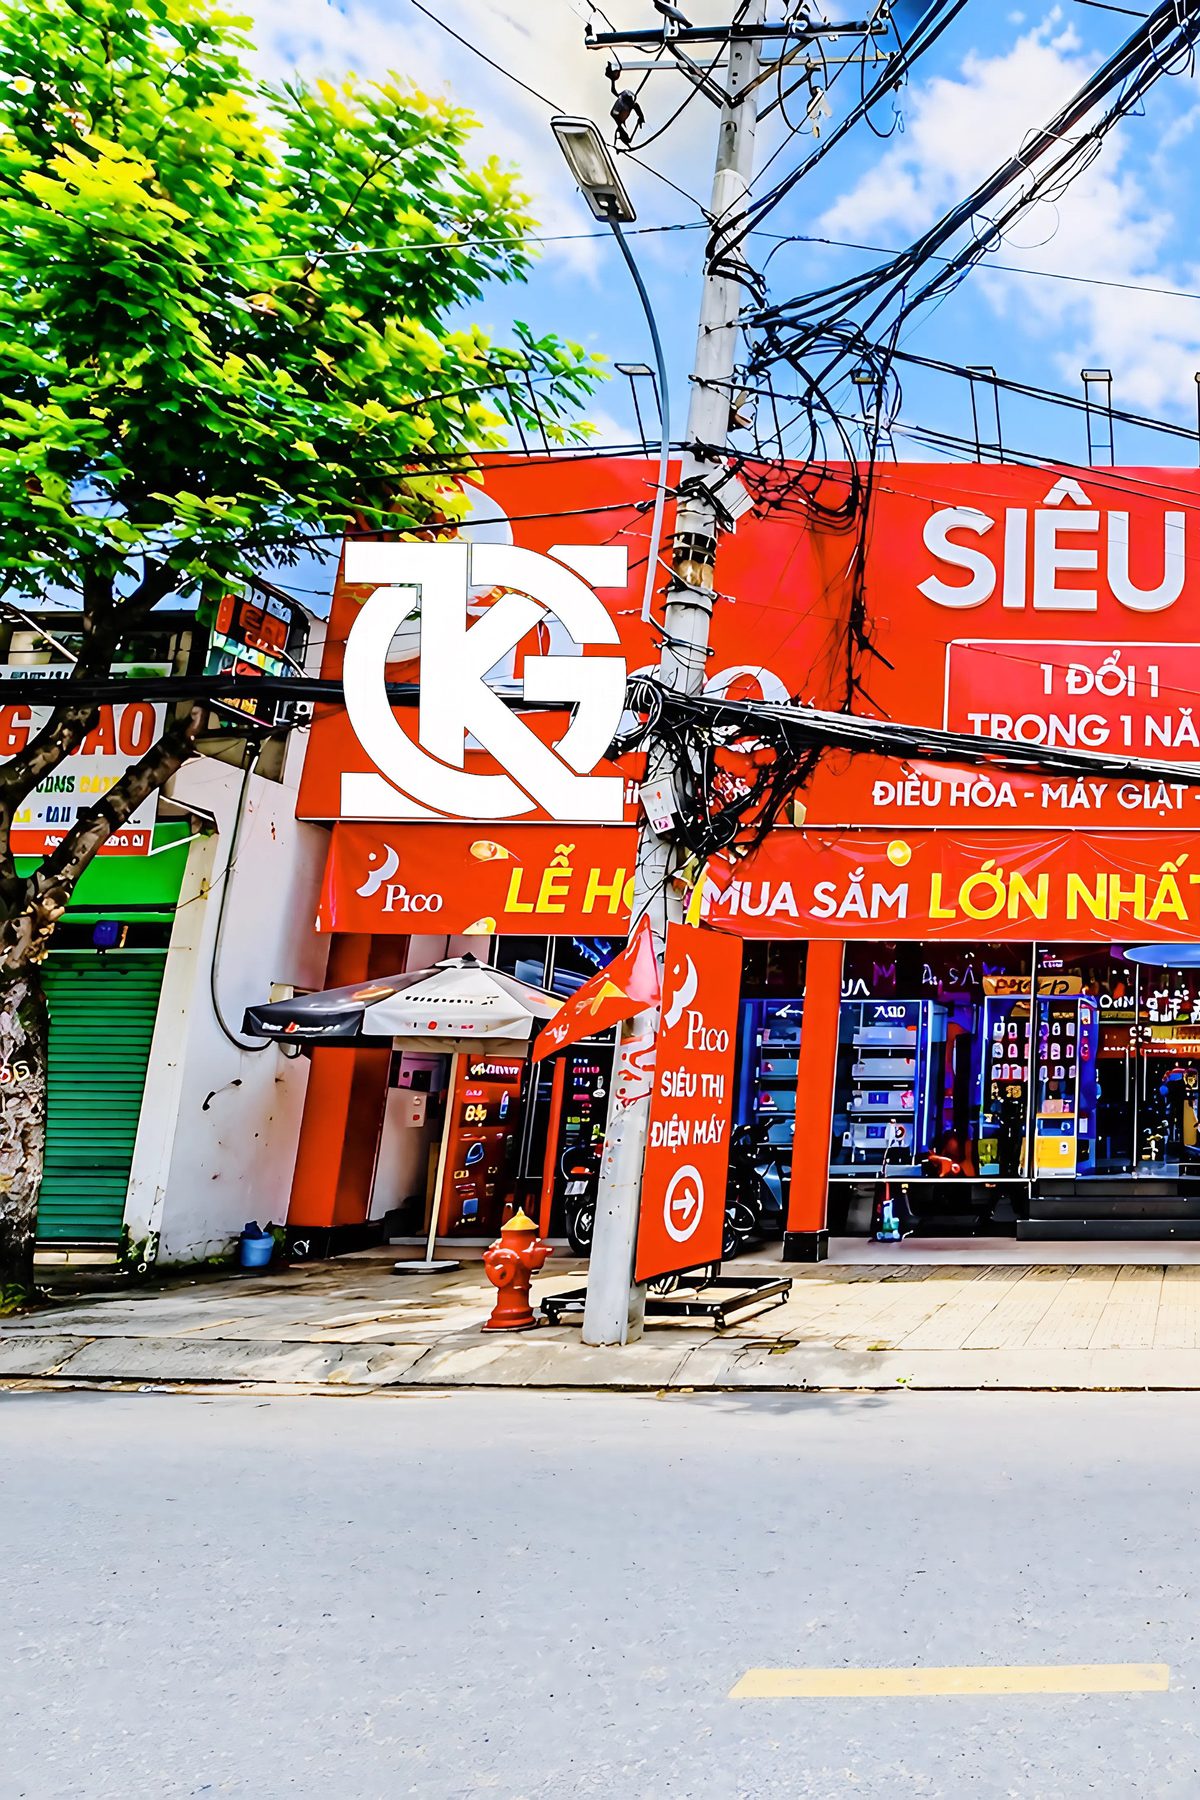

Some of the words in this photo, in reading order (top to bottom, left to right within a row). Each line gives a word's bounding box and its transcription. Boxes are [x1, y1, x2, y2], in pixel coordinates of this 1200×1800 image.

[917, 477, 1187, 612] SIÊU
[1040, 664, 1054, 695] 1
[1065, 650, 1136, 697] ĐỔI
[1147, 665, 1160, 698] 1
[967, 713, 1111, 746] TRONG
[1119, 715, 1132, 746] 1
[872, 760, 942, 807] ĐIỀU
[949, 773, 1018, 808] HÒA
[1041, 776, 1108, 809] MÁY
[504, 843, 573, 913] LỄ
[699, 876, 800, 917] MUA
[808, 866, 909, 919] SẮM
[928, 859, 1049, 920] LỚN
[660, 1065, 697, 1099] SIÊU
[700, 1073, 725, 1105] THỊ
[650, 1113, 693, 1154] ĐIỆN
[695, 1113, 726, 1145] MÁY
